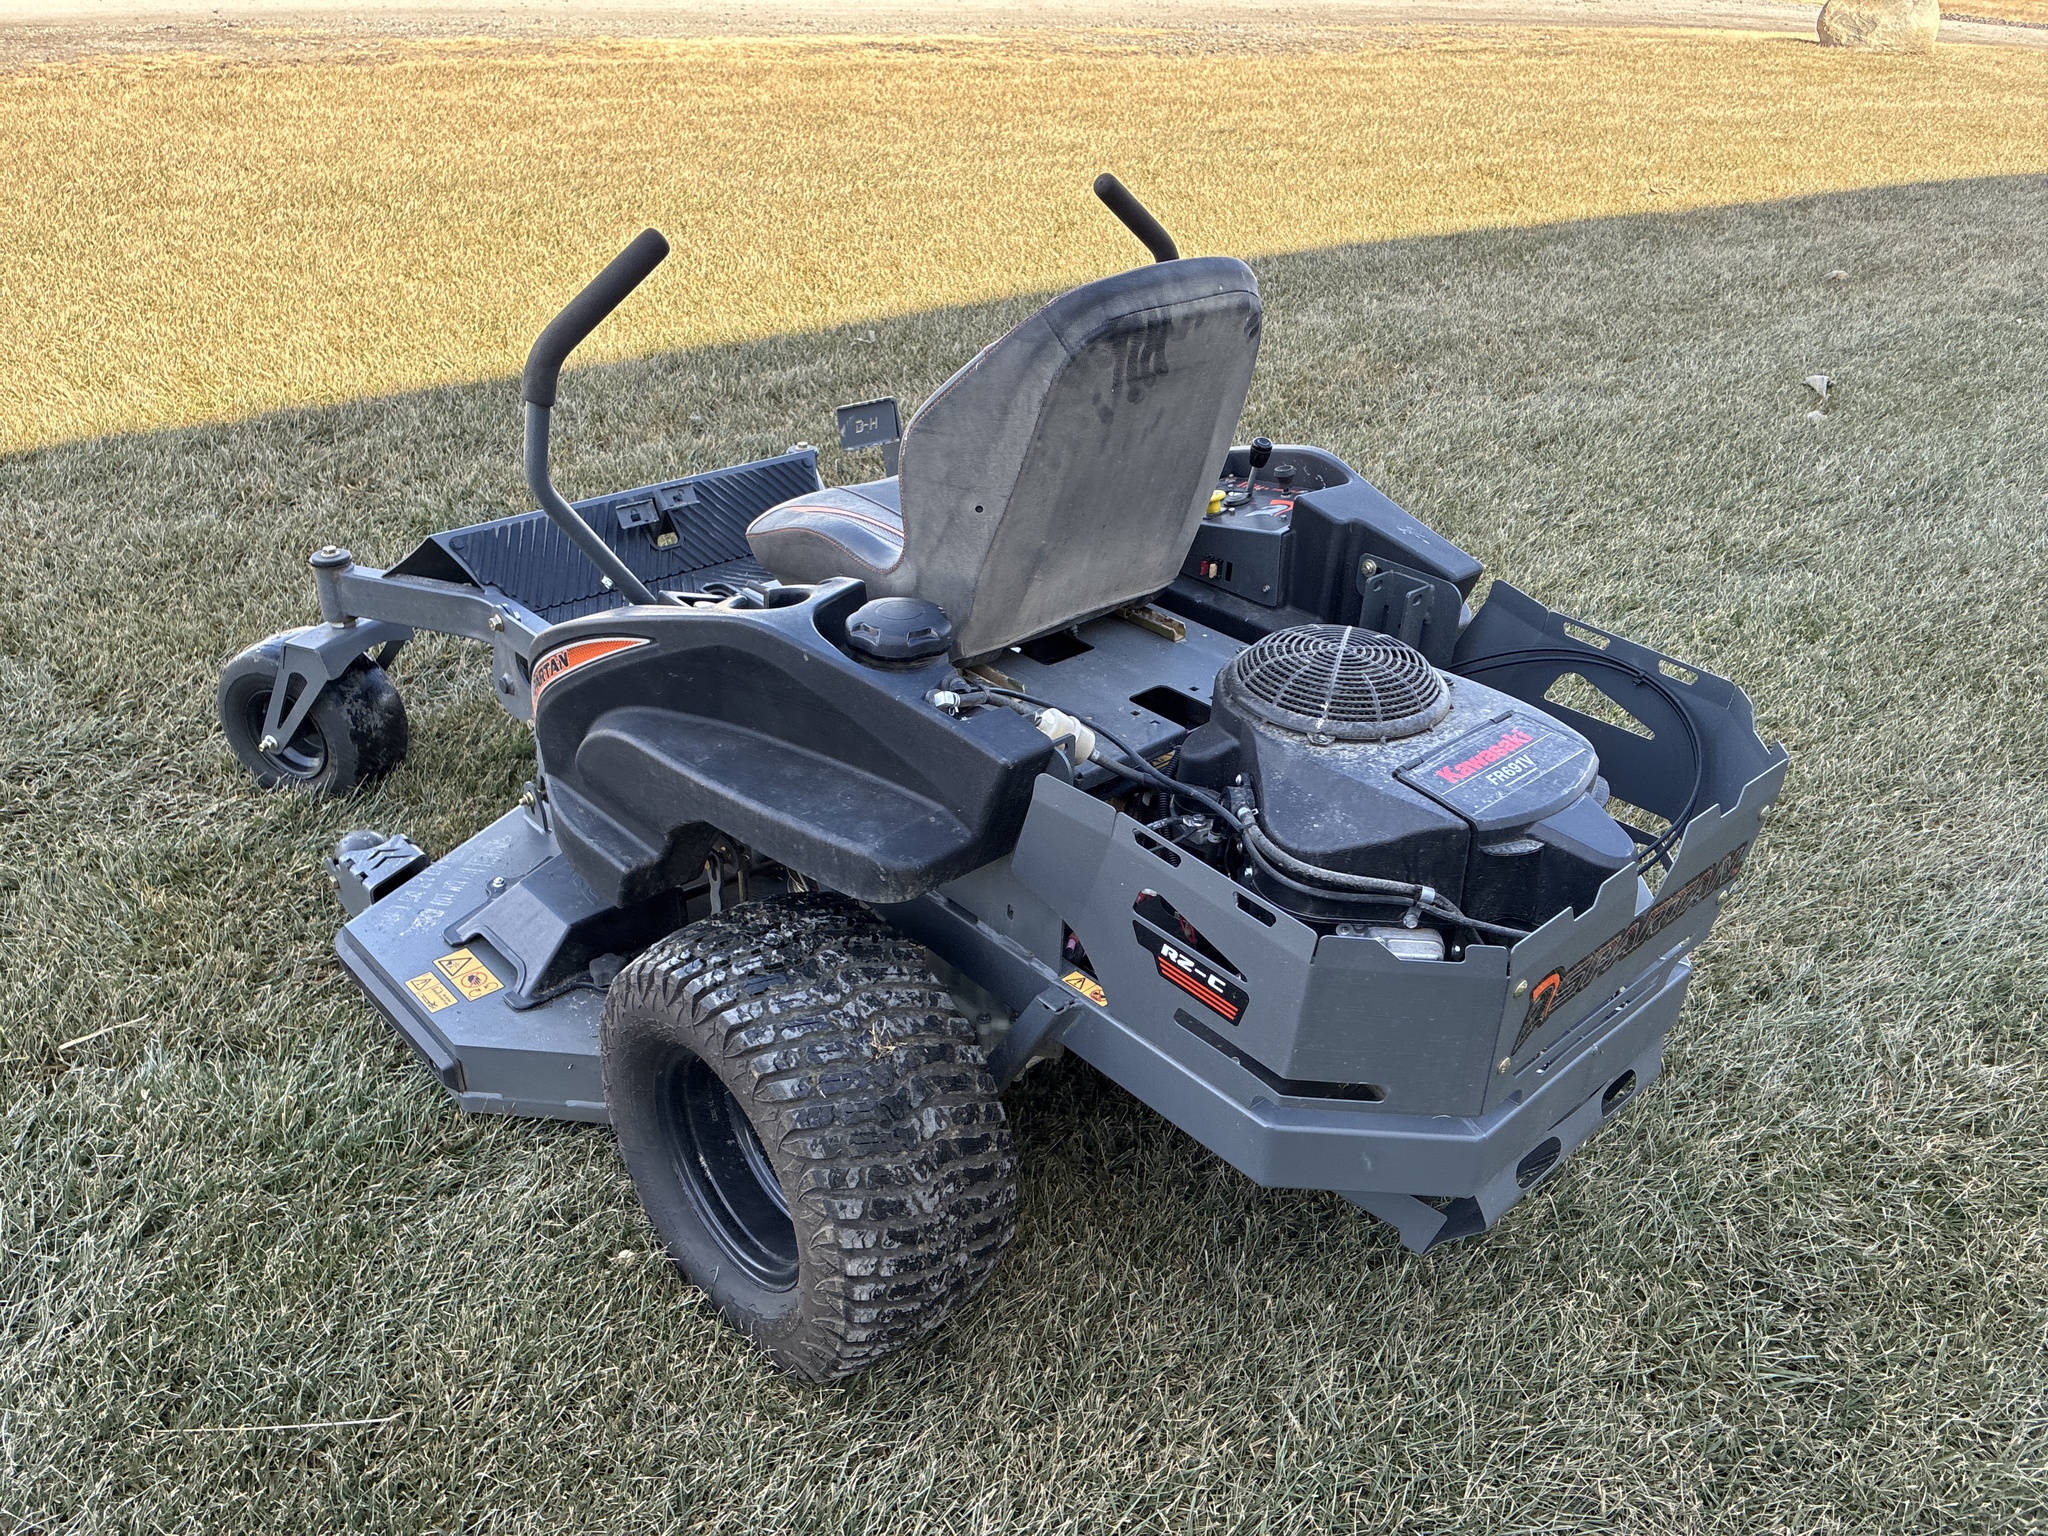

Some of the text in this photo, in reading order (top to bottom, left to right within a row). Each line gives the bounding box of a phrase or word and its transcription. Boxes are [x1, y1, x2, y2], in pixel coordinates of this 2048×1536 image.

[1435, 727, 1533, 784] Kawasaki
[1485, 754, 1535, 786] FR691V
[1545, 841, 1748, 1014] SPARTAN
[1160, 943, 1226, 993] RZ-C
